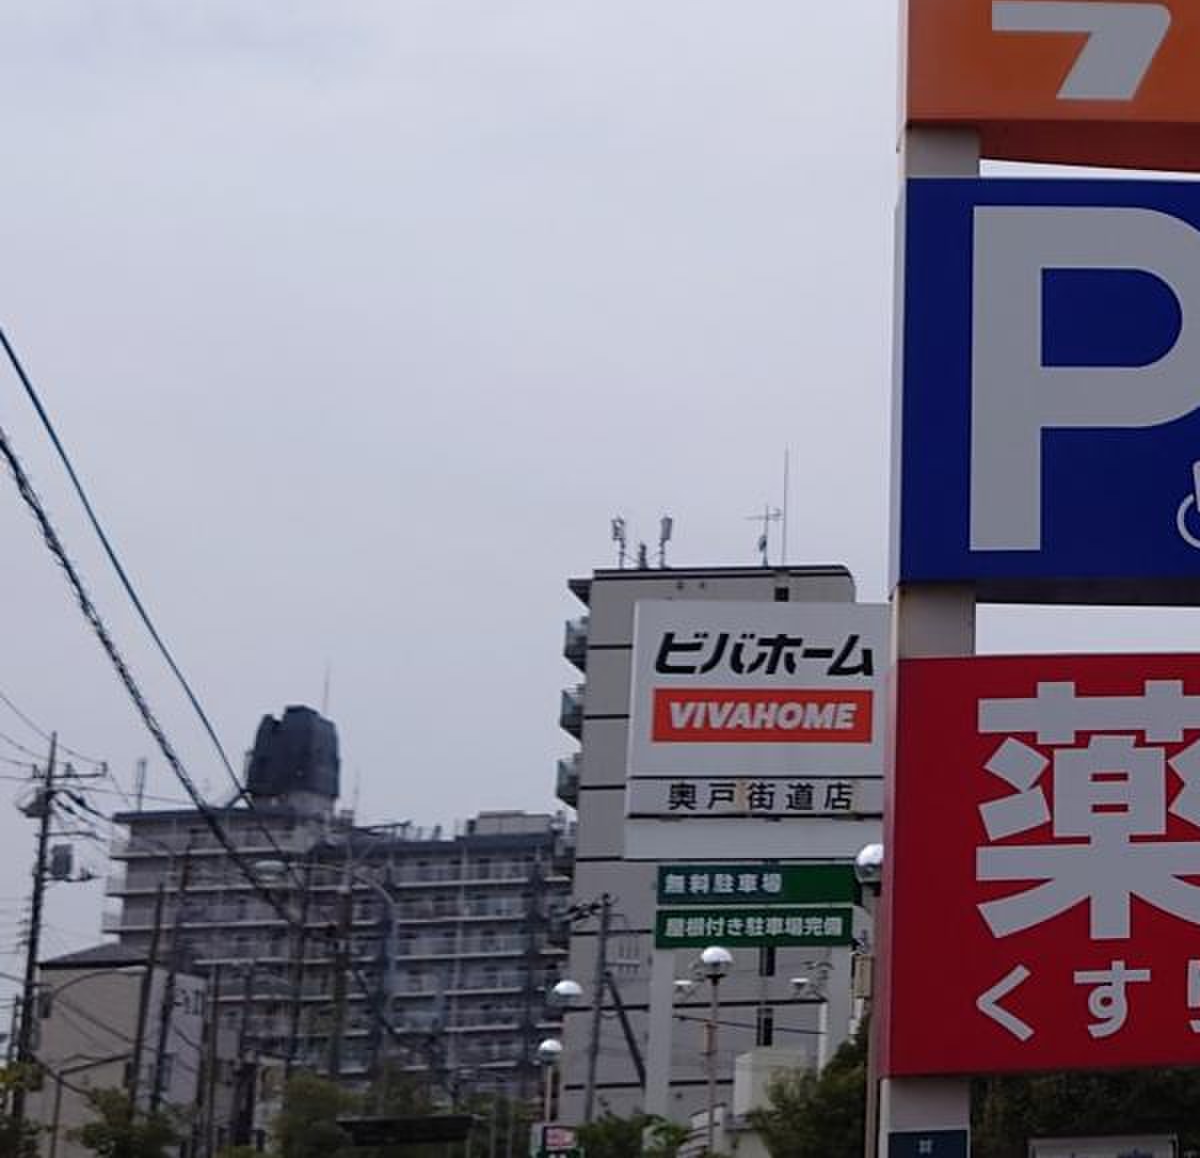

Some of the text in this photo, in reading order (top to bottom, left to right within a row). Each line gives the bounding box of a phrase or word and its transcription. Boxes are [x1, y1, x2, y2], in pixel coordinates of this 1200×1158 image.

[655, 631, 873, 676] ビバホーム
[670, 701, 857, 729] VIVAHOME
[668, 782, 853, 810] 奥戸街道店
